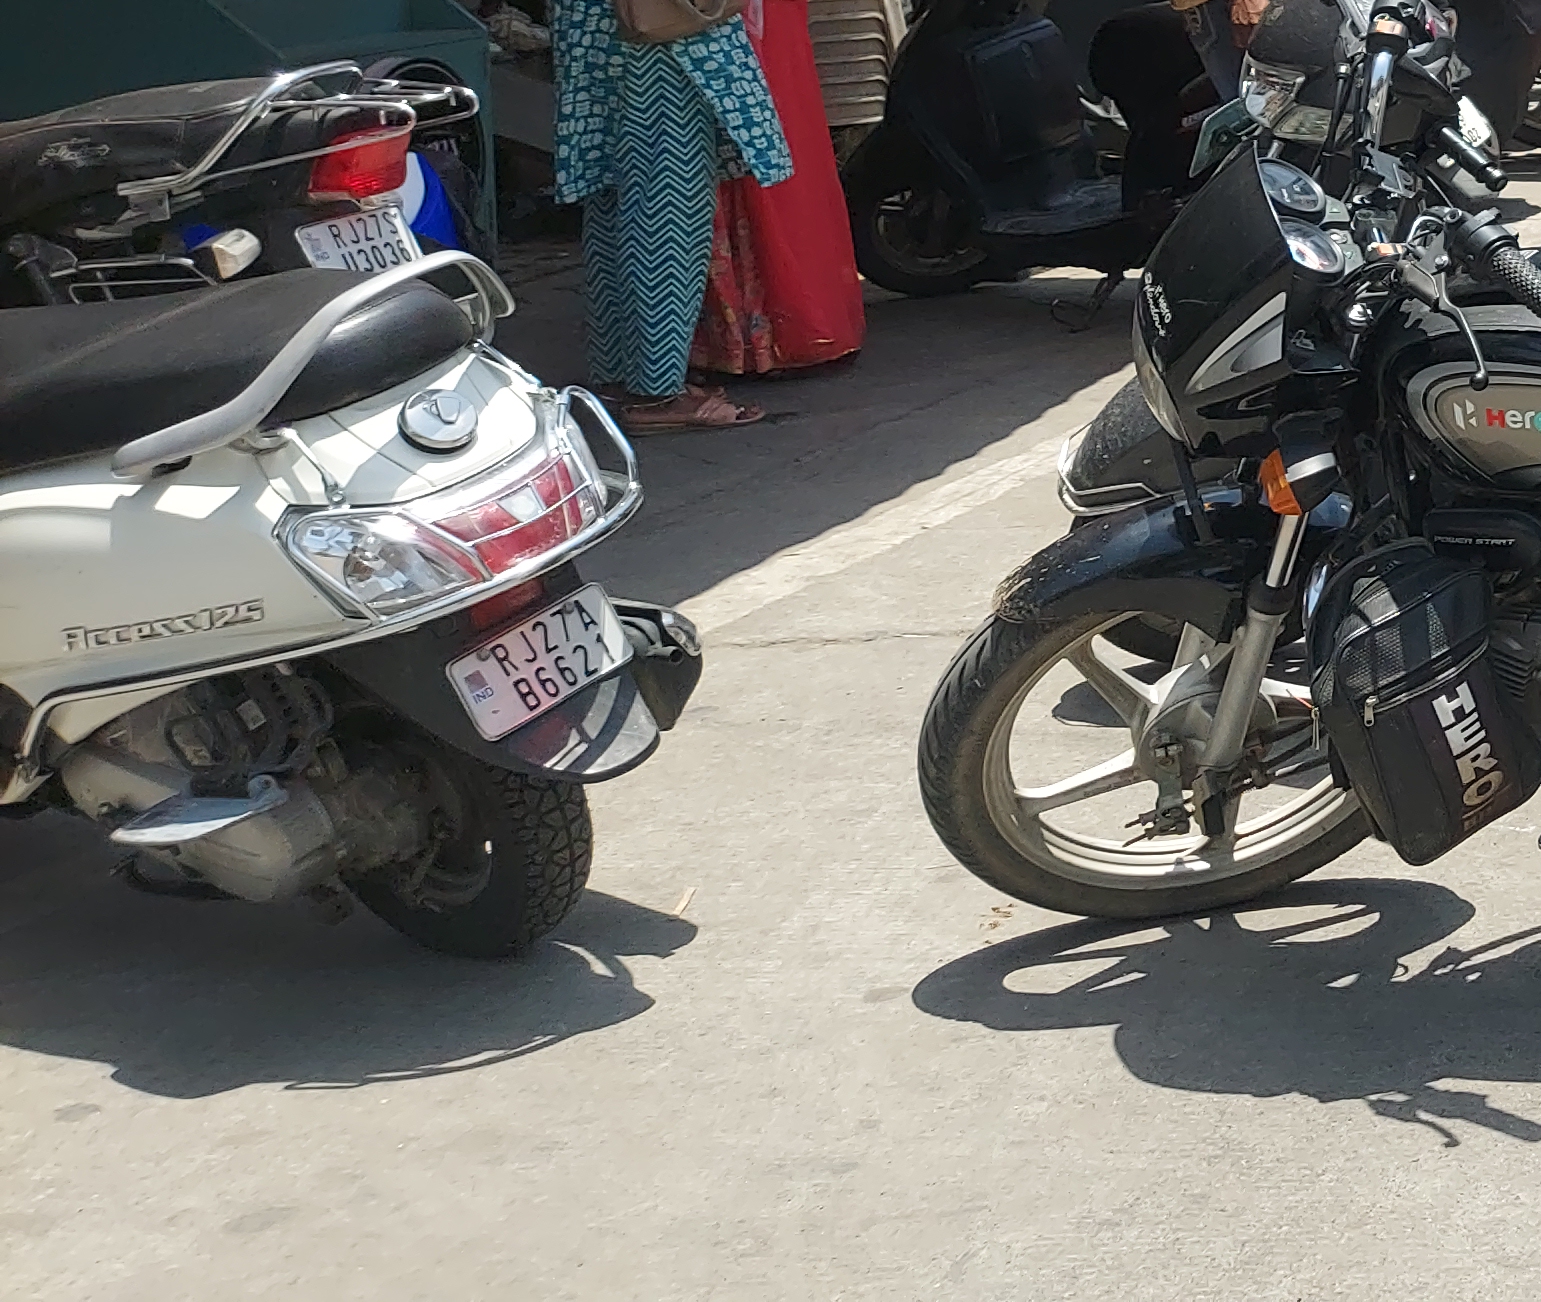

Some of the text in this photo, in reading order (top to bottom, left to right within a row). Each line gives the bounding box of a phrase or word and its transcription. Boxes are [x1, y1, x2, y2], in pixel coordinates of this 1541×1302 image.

[328, 211, 400, 250] RJ27S
[1433, 534, 1517, 548] POWER START
[200, 598, 267, 629] 125
[491, 599, 598, 677] RJ27A
[514, 634, 617, 712] B6621
[472, 686, 495, 706] IND
[1432, 680, 1505, 807] HERO
